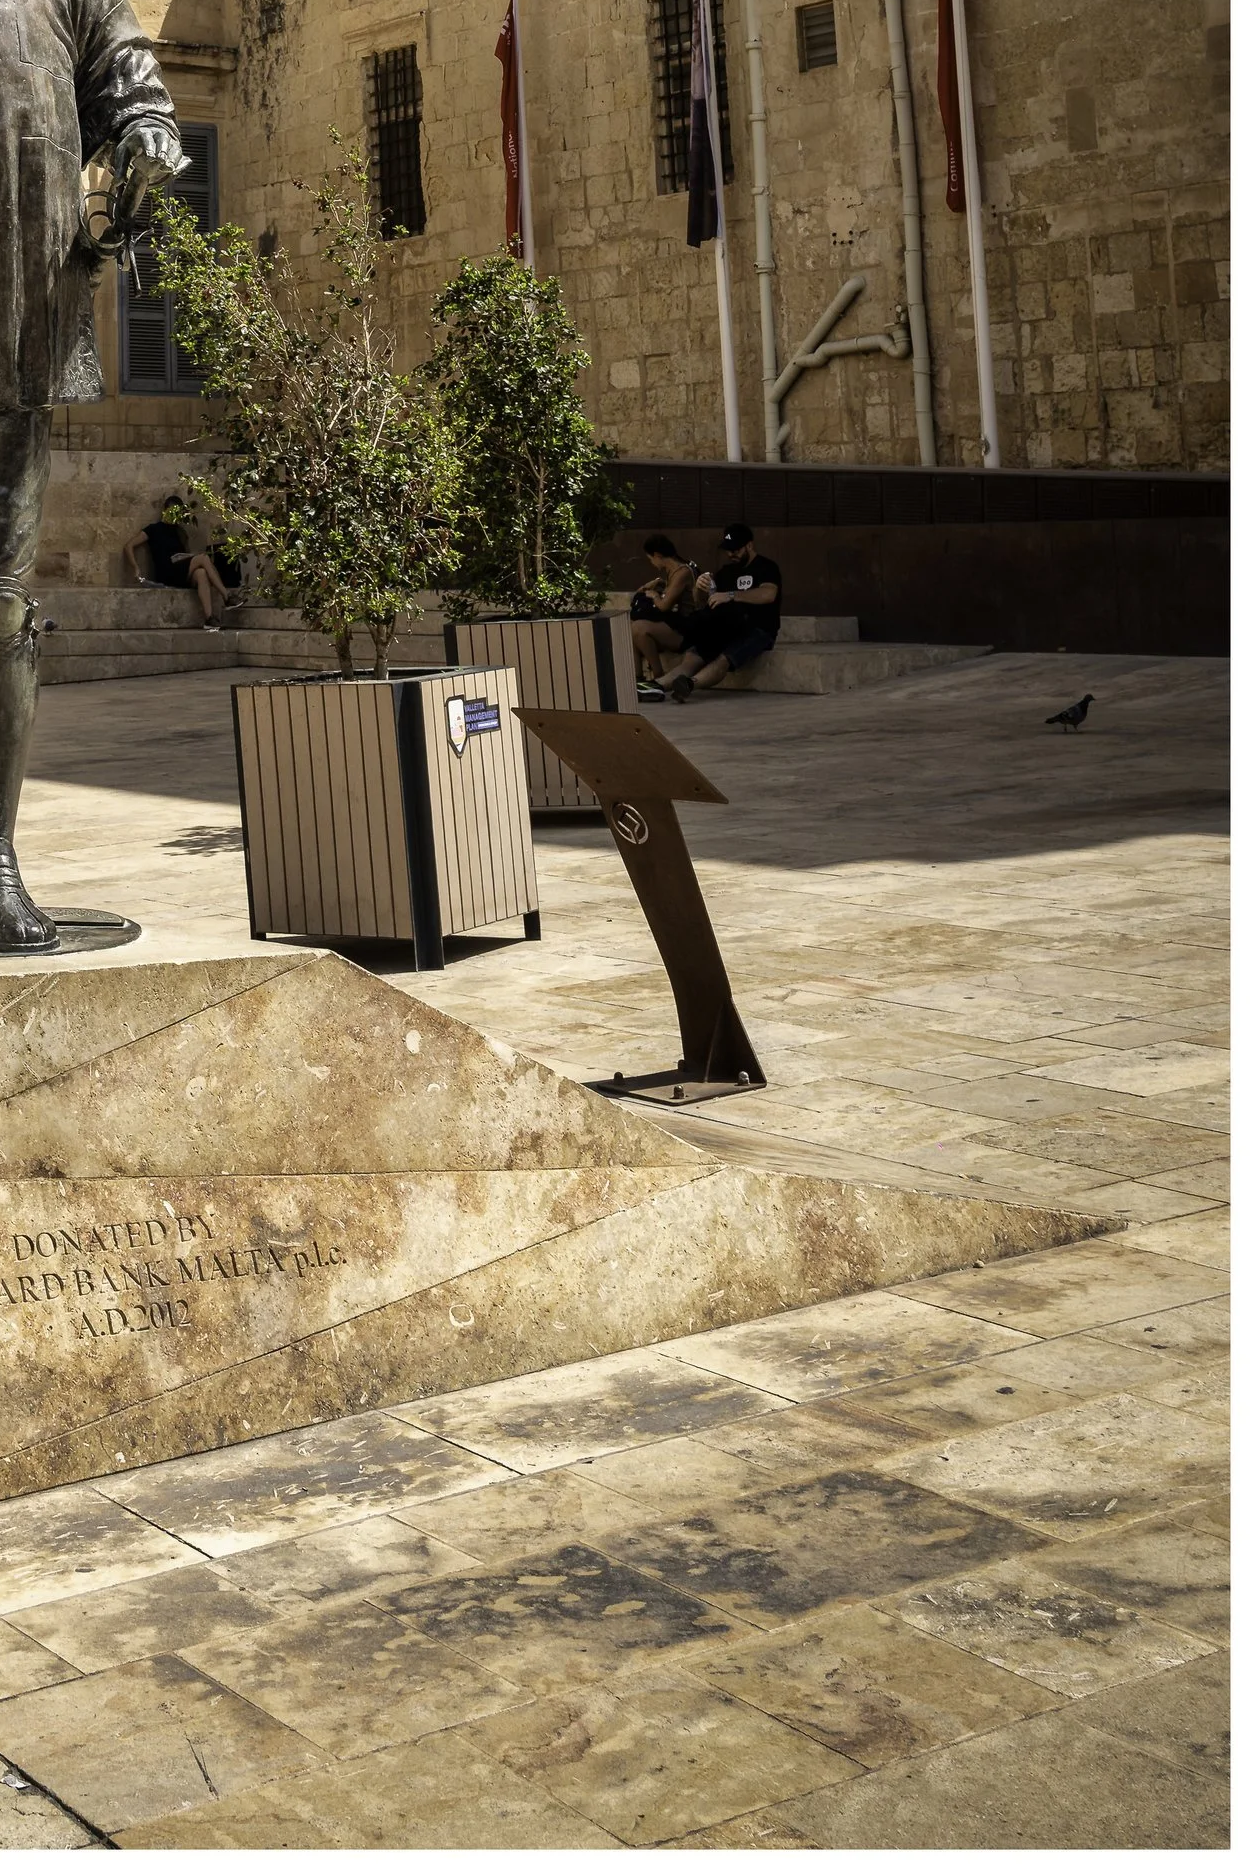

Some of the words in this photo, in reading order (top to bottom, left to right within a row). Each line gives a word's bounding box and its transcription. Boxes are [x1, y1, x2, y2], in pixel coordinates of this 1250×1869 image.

[739, 579, 751, 587] boo
[464, 702, 485, 712] VALLETTA
[464, 709, 498, 723] MANAGEMENT
[466, 723, 478, 732] PLAN
[11, 1218, 167, 1262] DONATED
[177, 1213, 216, 1243] BY
[73, 1260, 171, 1296] BANK
[176, 1246, 285, 1284] MALTA
[293, 1240, 348, 1277] p.l.c.
